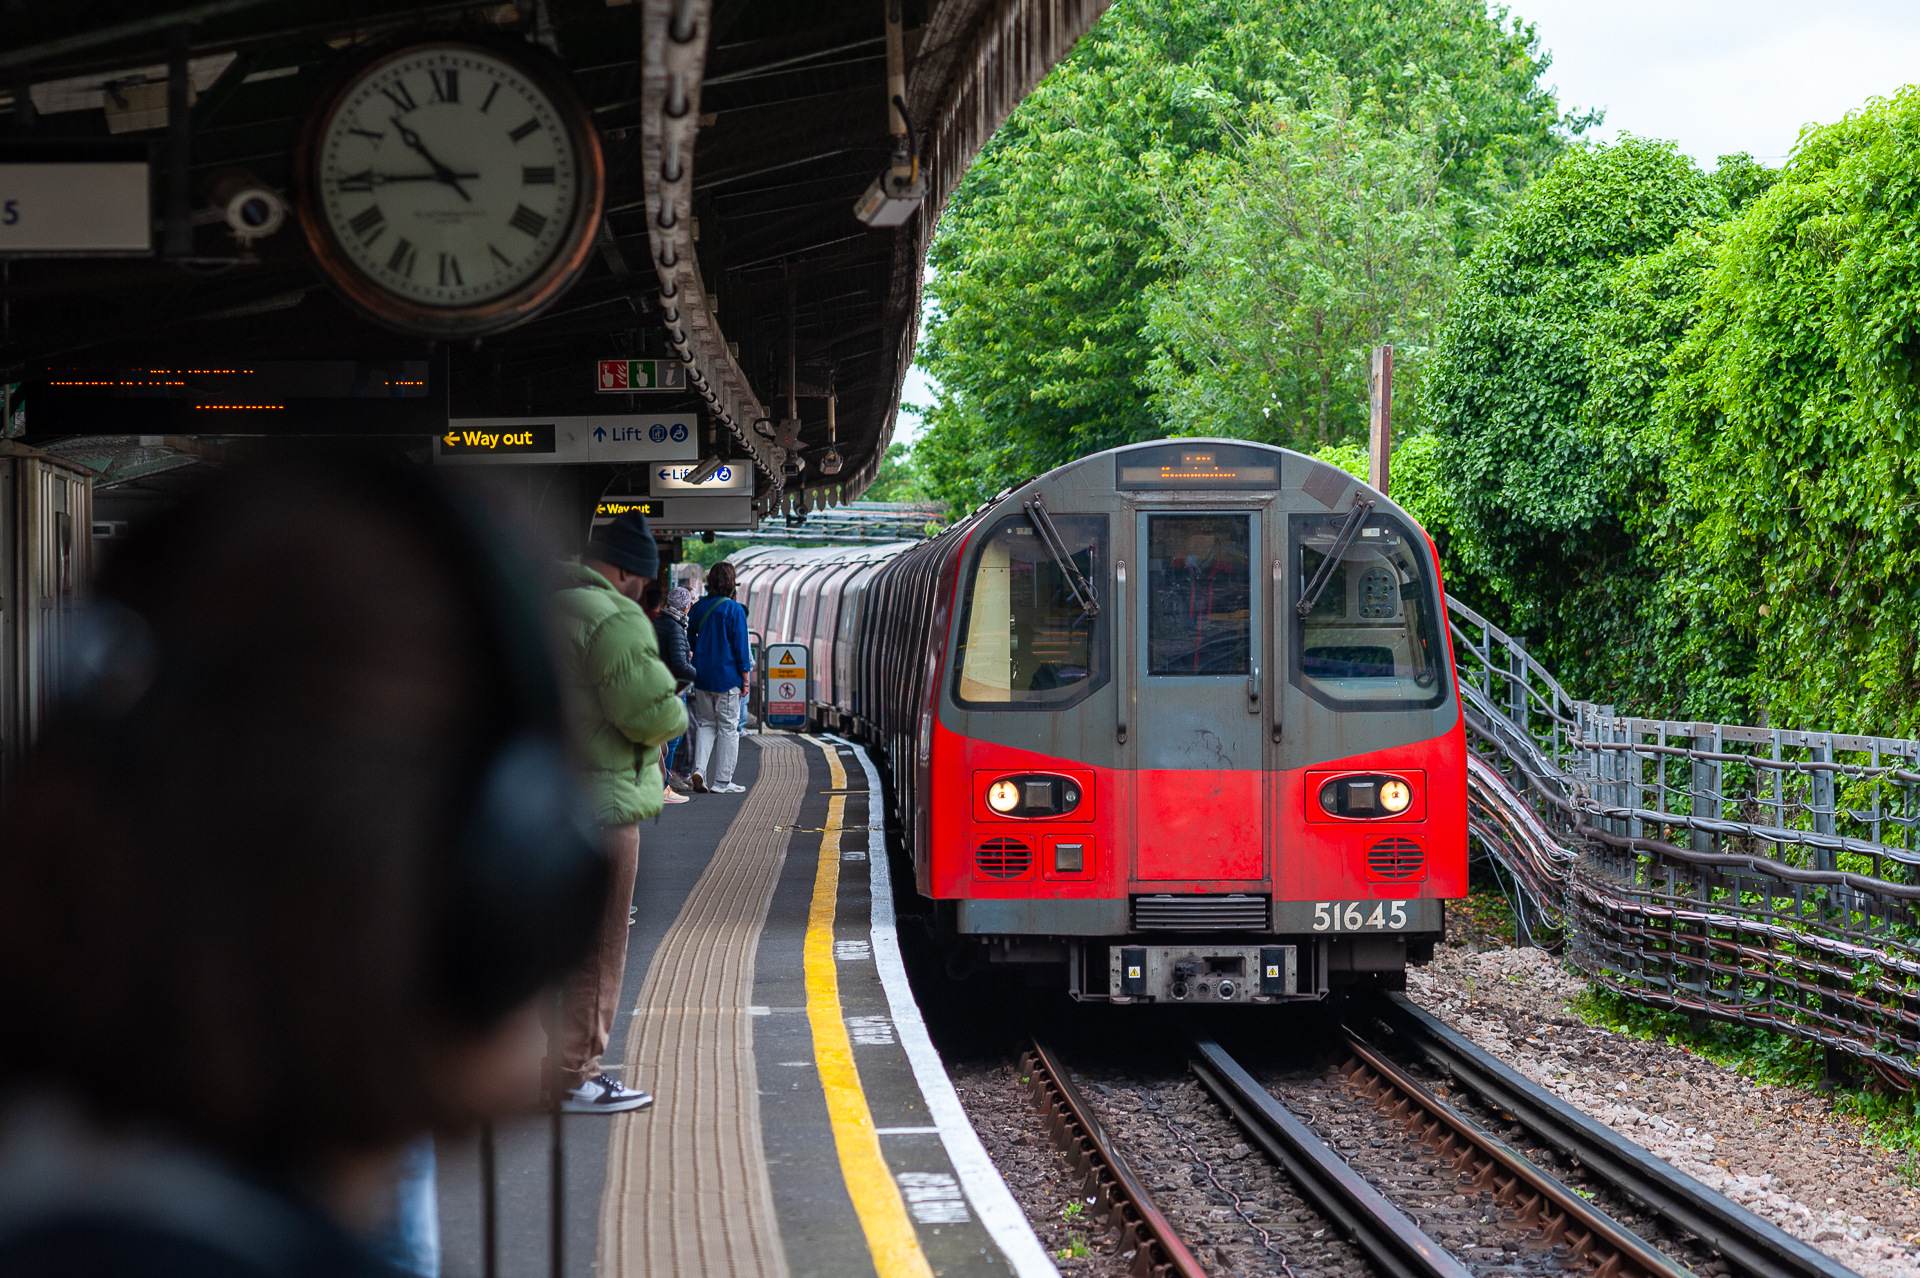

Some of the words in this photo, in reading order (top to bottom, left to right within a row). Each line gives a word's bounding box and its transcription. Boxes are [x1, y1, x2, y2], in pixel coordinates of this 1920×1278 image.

[427, 69, 458, 104] XII
[509, 117, 541, 142] II
[523, 166, 556, 185] III
[3, 201, 19, 225] 5
[463, 431, 499, 449] Way
[503, 431, 533, 445] out
[613, 427, 642, 441] Lift
[673, 469, 693, 479] Lif
[1312, 900, 1407, 931] 51645
